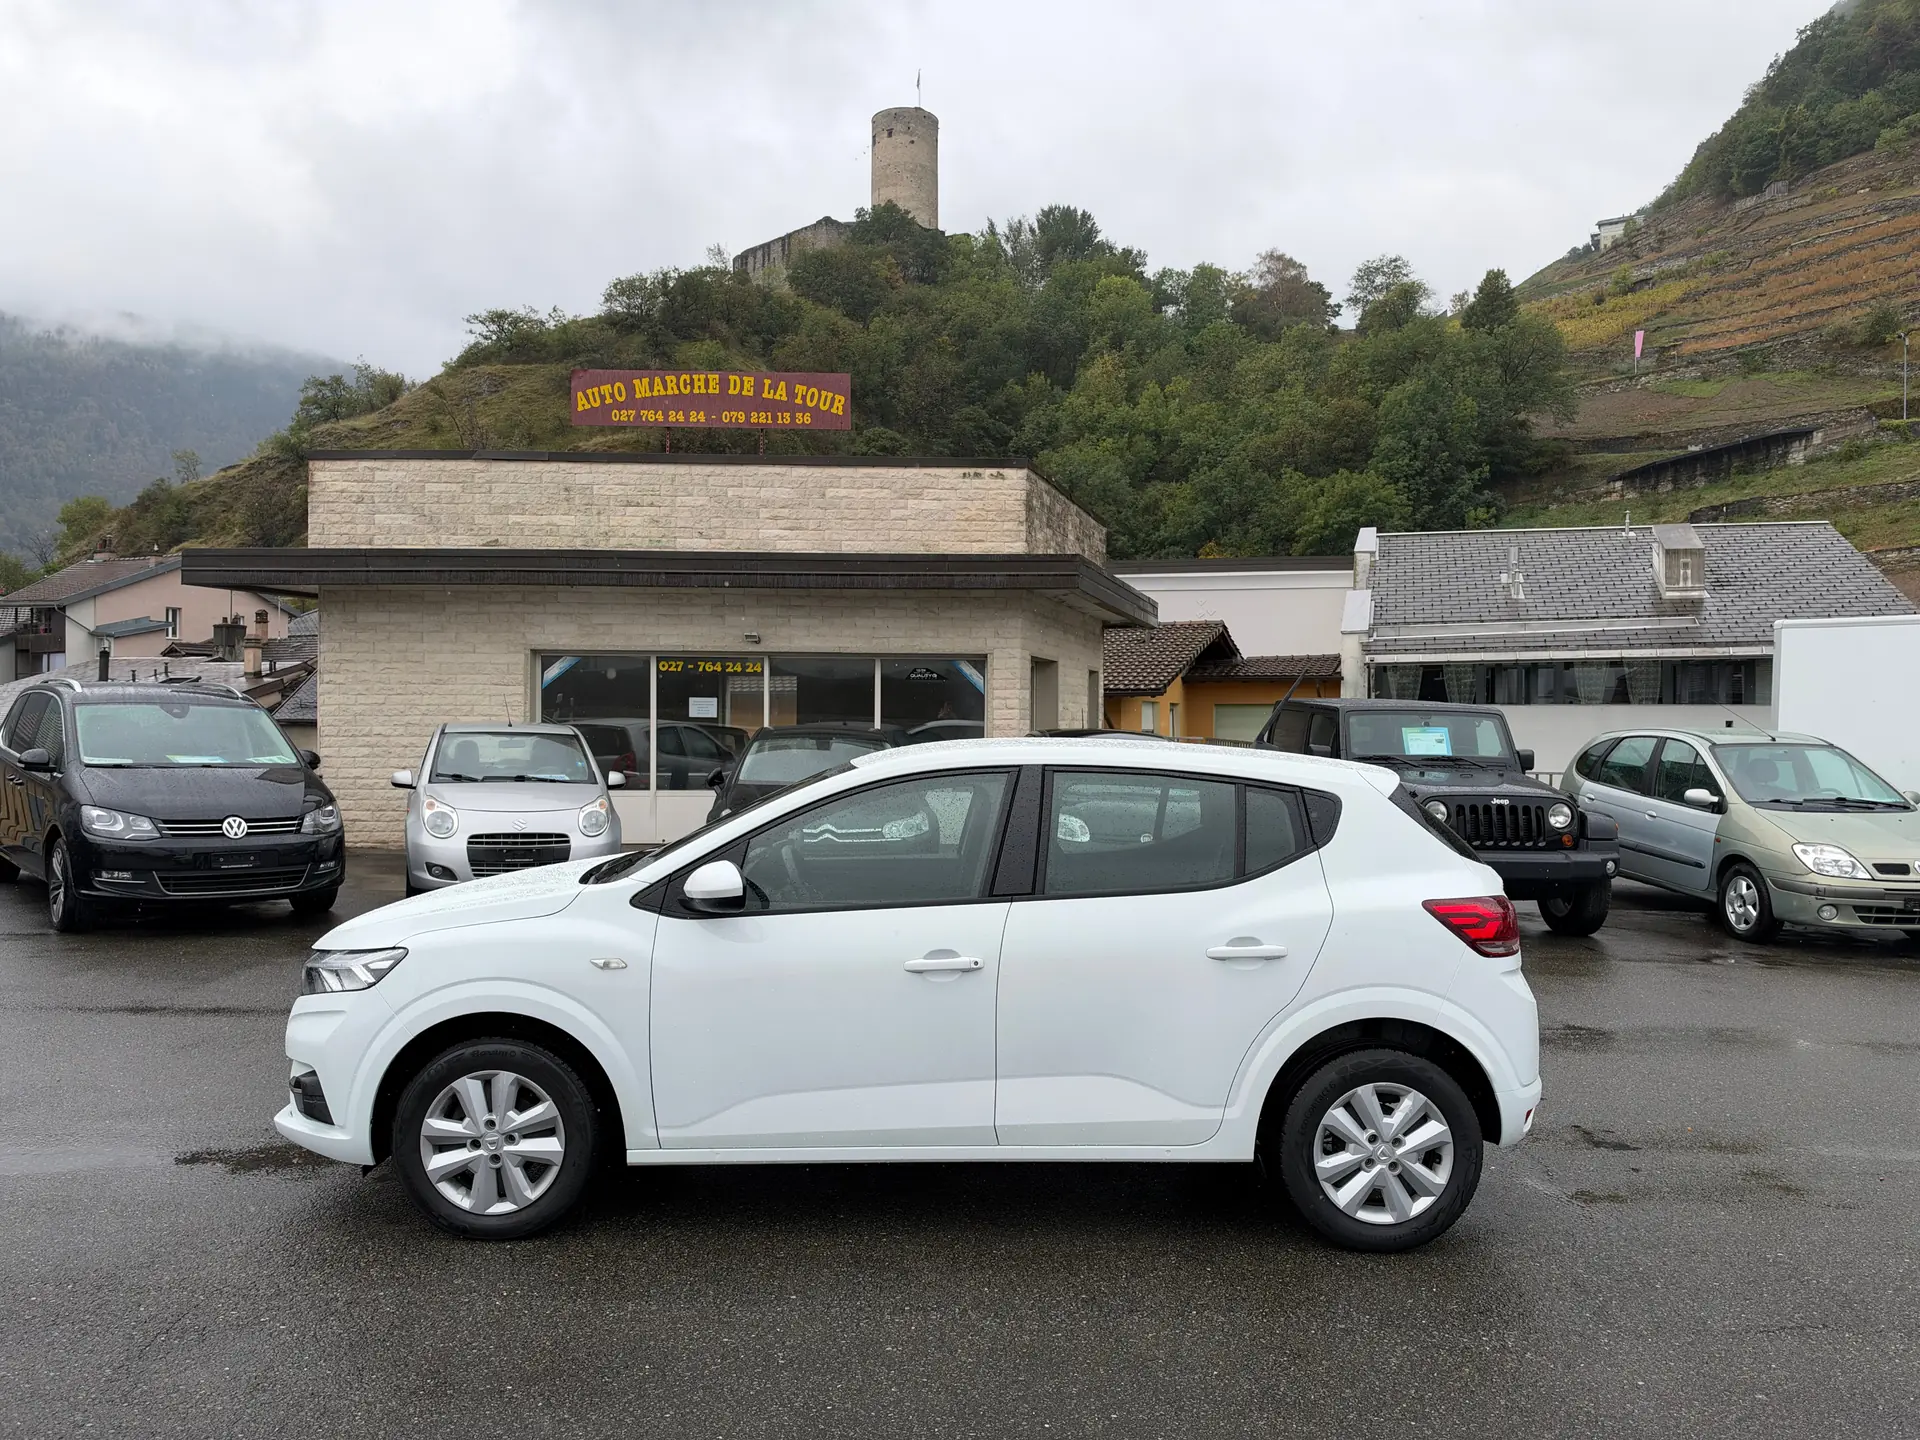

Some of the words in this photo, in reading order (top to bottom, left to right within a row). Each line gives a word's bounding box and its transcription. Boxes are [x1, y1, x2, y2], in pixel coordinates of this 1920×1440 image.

[577, 382, 626, 411] AUTO
[633, 374, 720, 398] MARCHE
[728, 375, 754, 396] DE
[762, 379, 787, 401] LA
[795, 384, 845, 415] TOUR
[612, 410, 636, 421] 027
[640, 410, 664, 422] 764
[668, 411, 685, 422] 24
[690, 411, 706, 422] 24
[722, 411, 745, 423] 079
[750, 411, 773, 424] 221
[777, 412, 791, 424] 13
[795, 412, 811, 424] 36
[659, 661, 684, 671] 027
[698, 661, 722, 672] 764
[725, 662, 742, 672] 24
[745, 662, 762, 673] 24
[1491, 797, 1510, 806] Jeep
